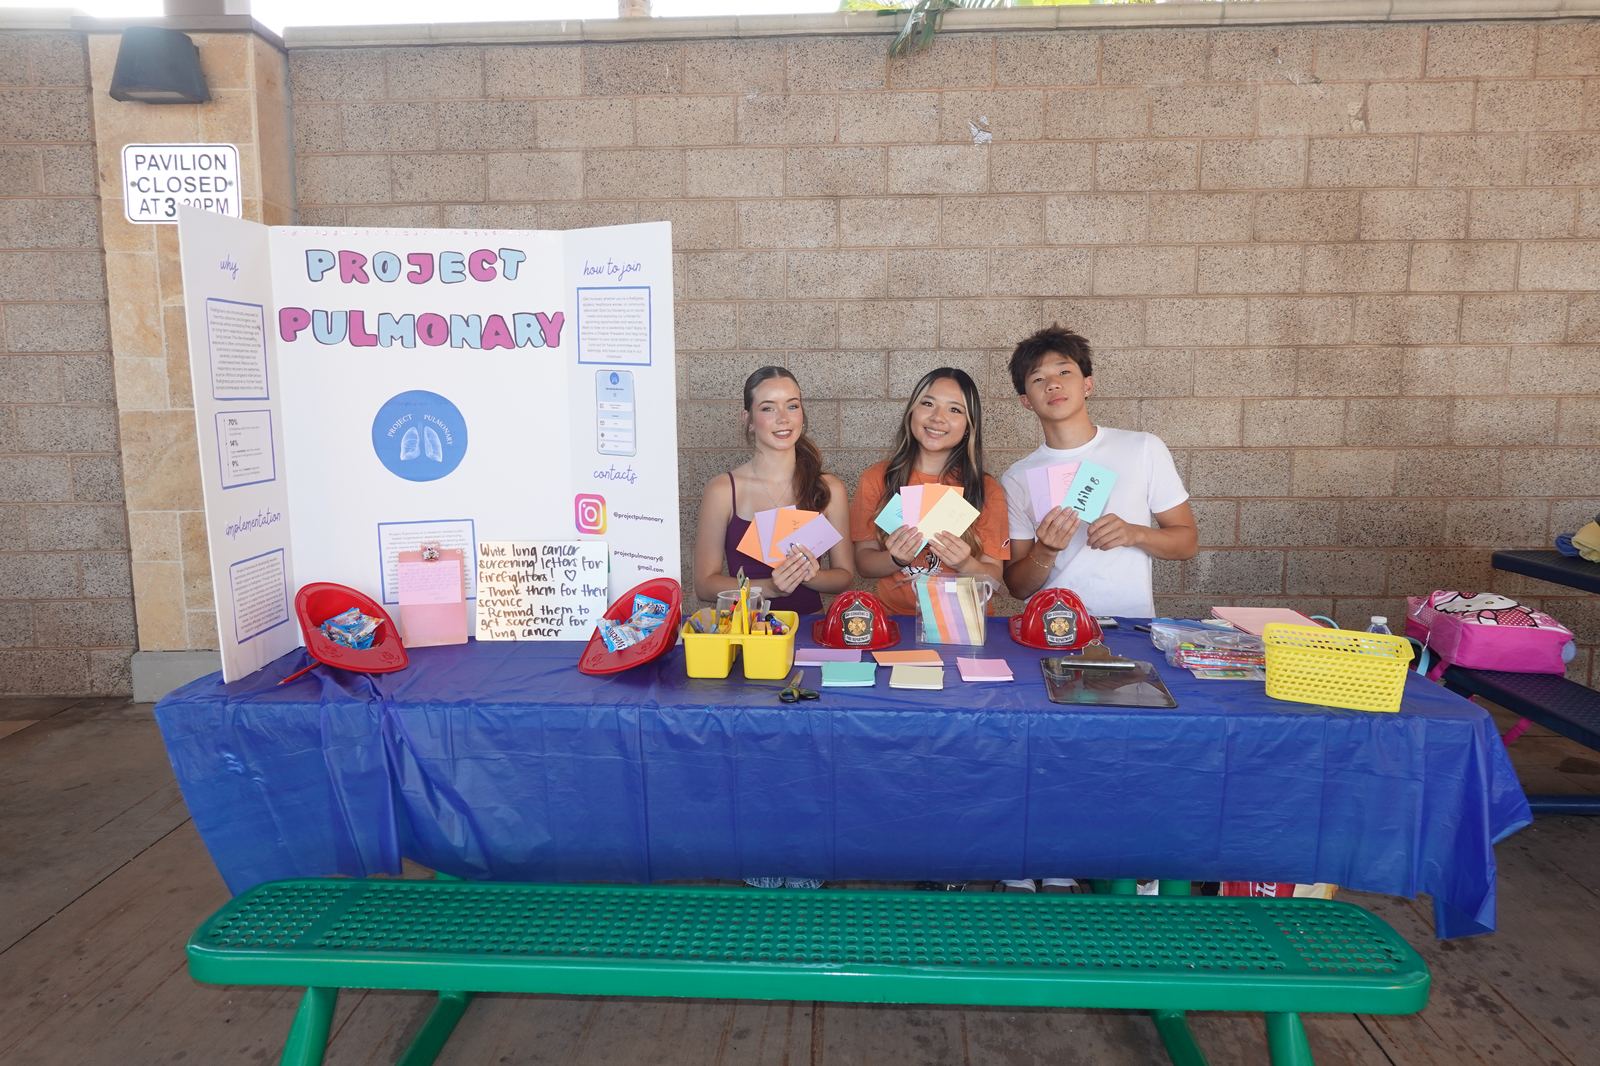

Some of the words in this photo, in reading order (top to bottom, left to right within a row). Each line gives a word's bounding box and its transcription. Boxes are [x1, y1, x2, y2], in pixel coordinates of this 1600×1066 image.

[135, 154, 226, 171] PAVILION
[137, 176, 228, 193] CLOSED
[140, 198, 160, 214] AT
[220, 253, 239, 280] why
[305, 248, 526, 284] PROJECT
[583, 260, 604, 276] how
[607, 257, 620, 275] to
[618, 262, 641, 281] join
[278, 307, 565, 350] PULMONARY
[386, 413, 413, 438] PROJECT
[593, 464, 638, 485] contacts
[225, 506, 281, 541] implementation
[613, 511, 664, 524] @projectpulmonary
[512, 544, 538, 563] lung
[542, 544, 580, 557] cancer
[613, 550, 664, 563] projectpulmonary@
[541, 557, 577, 569] letters
[582, 556, 603, 571] for
[637, 565, 665, 574] gmail.com
[488, 584, 521, 597] Thank
[526, 585, 556, 597] them
[560, 583, 577, 597] for
[581, 584, 608, 597] their
[478, 598, 523, 608] service
[488, 604, 534, 618] Remind
[541, 605, 573, 616] them
[577, 604, 590, 614] to
[481, 618, 499, 631] get
[569, 616, 588, 627] for
[490, 629, 517, 642] lung
[522, 628, 562, 638] cancer
